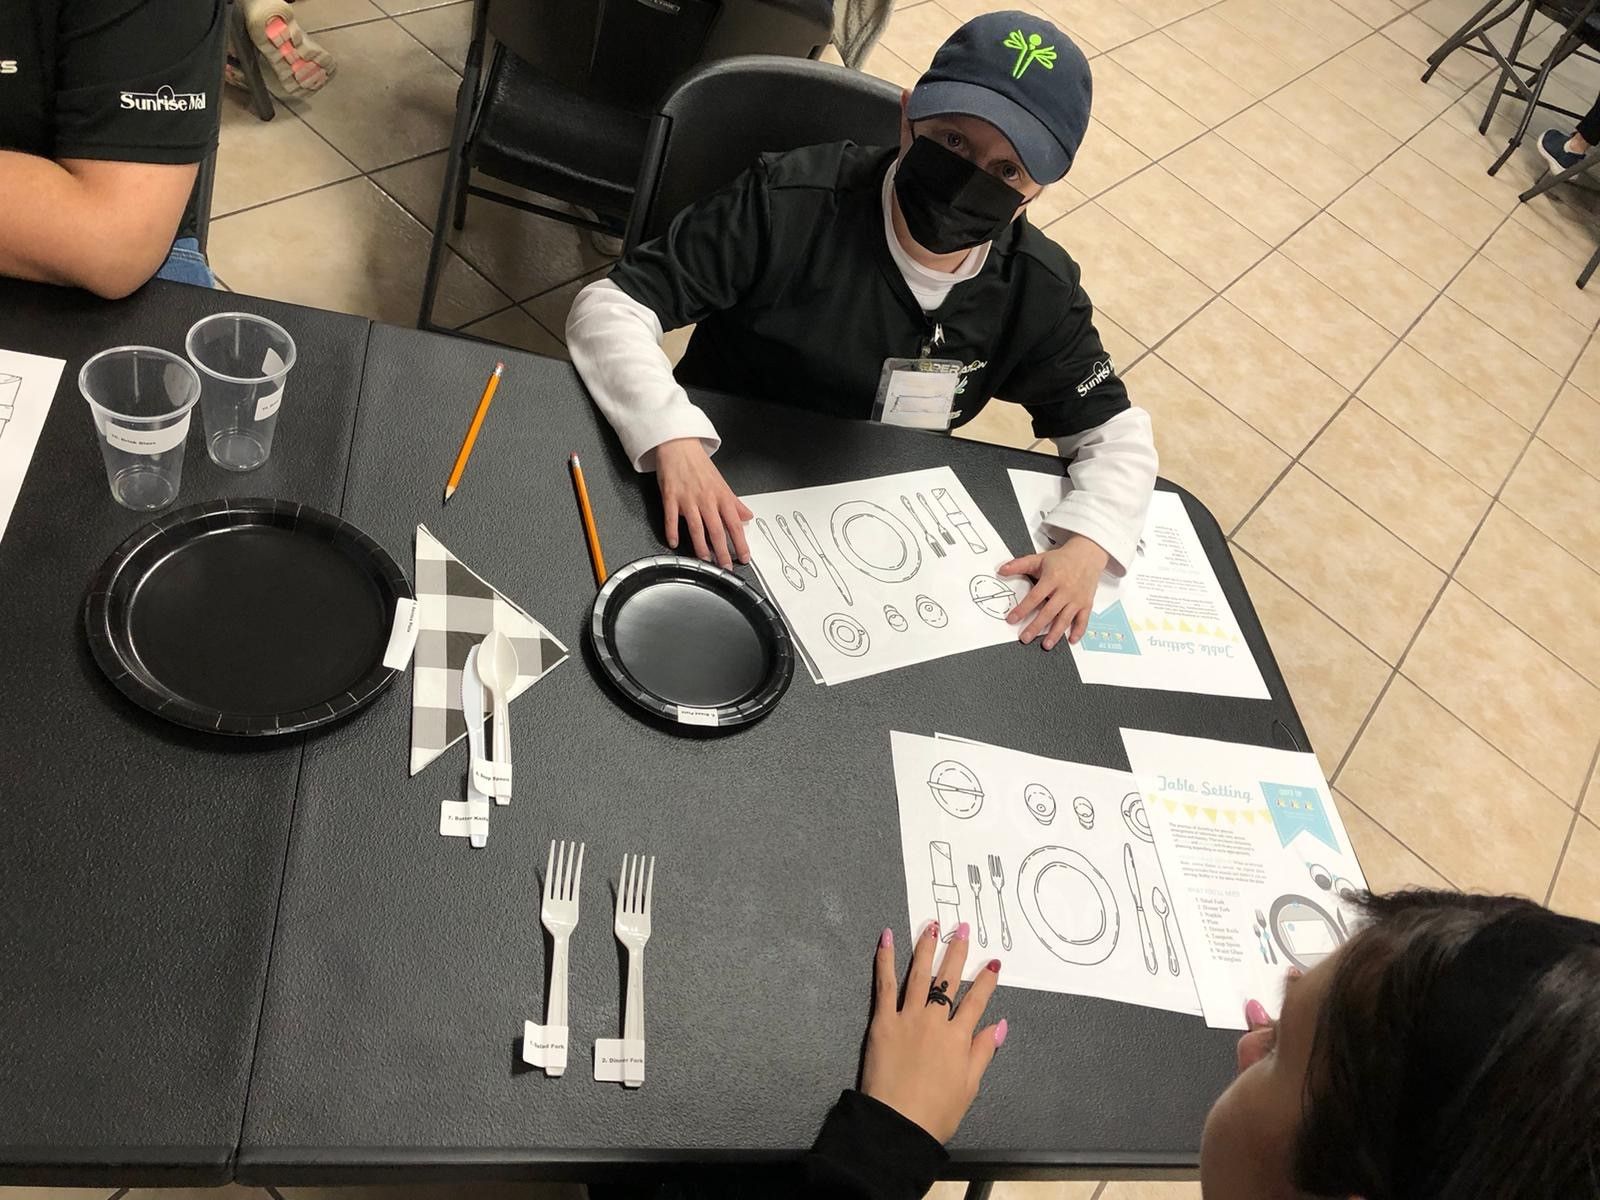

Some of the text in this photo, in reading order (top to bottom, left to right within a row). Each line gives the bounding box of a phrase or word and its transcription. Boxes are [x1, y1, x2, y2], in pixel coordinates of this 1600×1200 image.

[120, 93, 188, 111] Sunrise
[1147, 635, 1235, 658] Table Setting
[1157, 775, 1198, 793] Table
[1201, 780, 1254, 803] Setting
